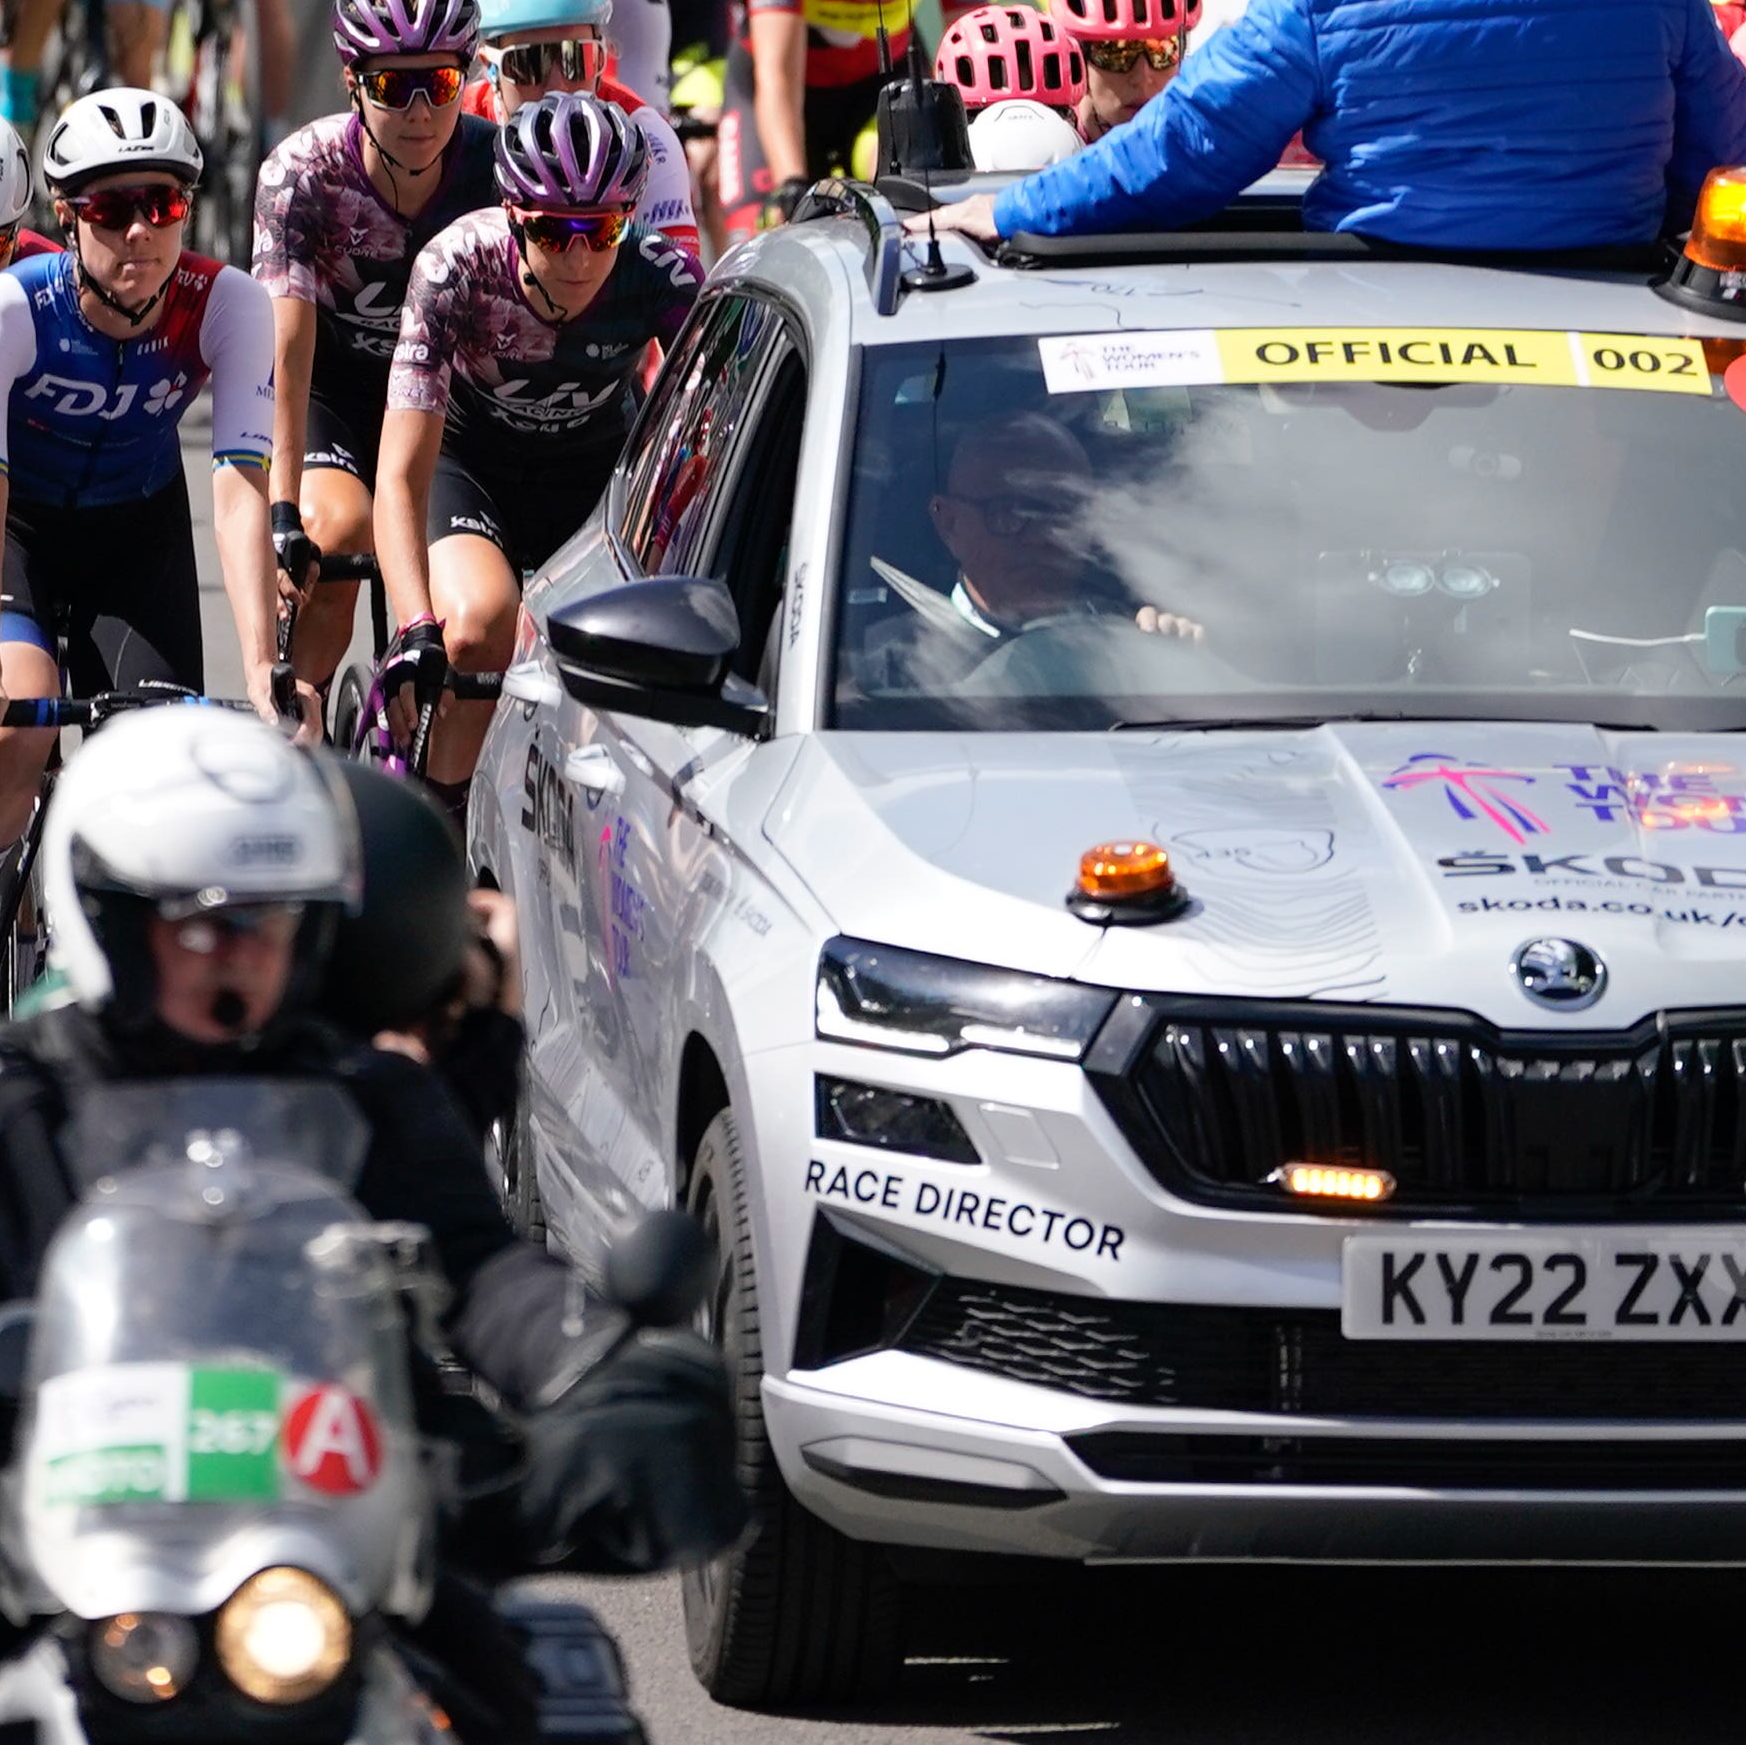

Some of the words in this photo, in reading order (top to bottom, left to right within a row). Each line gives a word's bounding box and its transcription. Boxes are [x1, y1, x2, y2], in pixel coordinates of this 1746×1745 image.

[117, 144, 156, 154] LAZER
[1103, 350, 1201, 363] WOMEN'S
[1254, 336, 1538, 375] OFFICIAL
[1592, 345, 1697, 380] 002
[24, 373, 140, 421] FDJ
[492, 378, 621, 410] Liv
[1552, 763, 1719, 794] THE
[1534, 876, 1632, 893] OFFICIAL
[804, 1159, 902, 1210] RACE
[914, 1183, 1127, 1263] DIRECTOR
[1379, 1251, 1589, 1328] KY22
[298, 1388, 373, 1484] A
